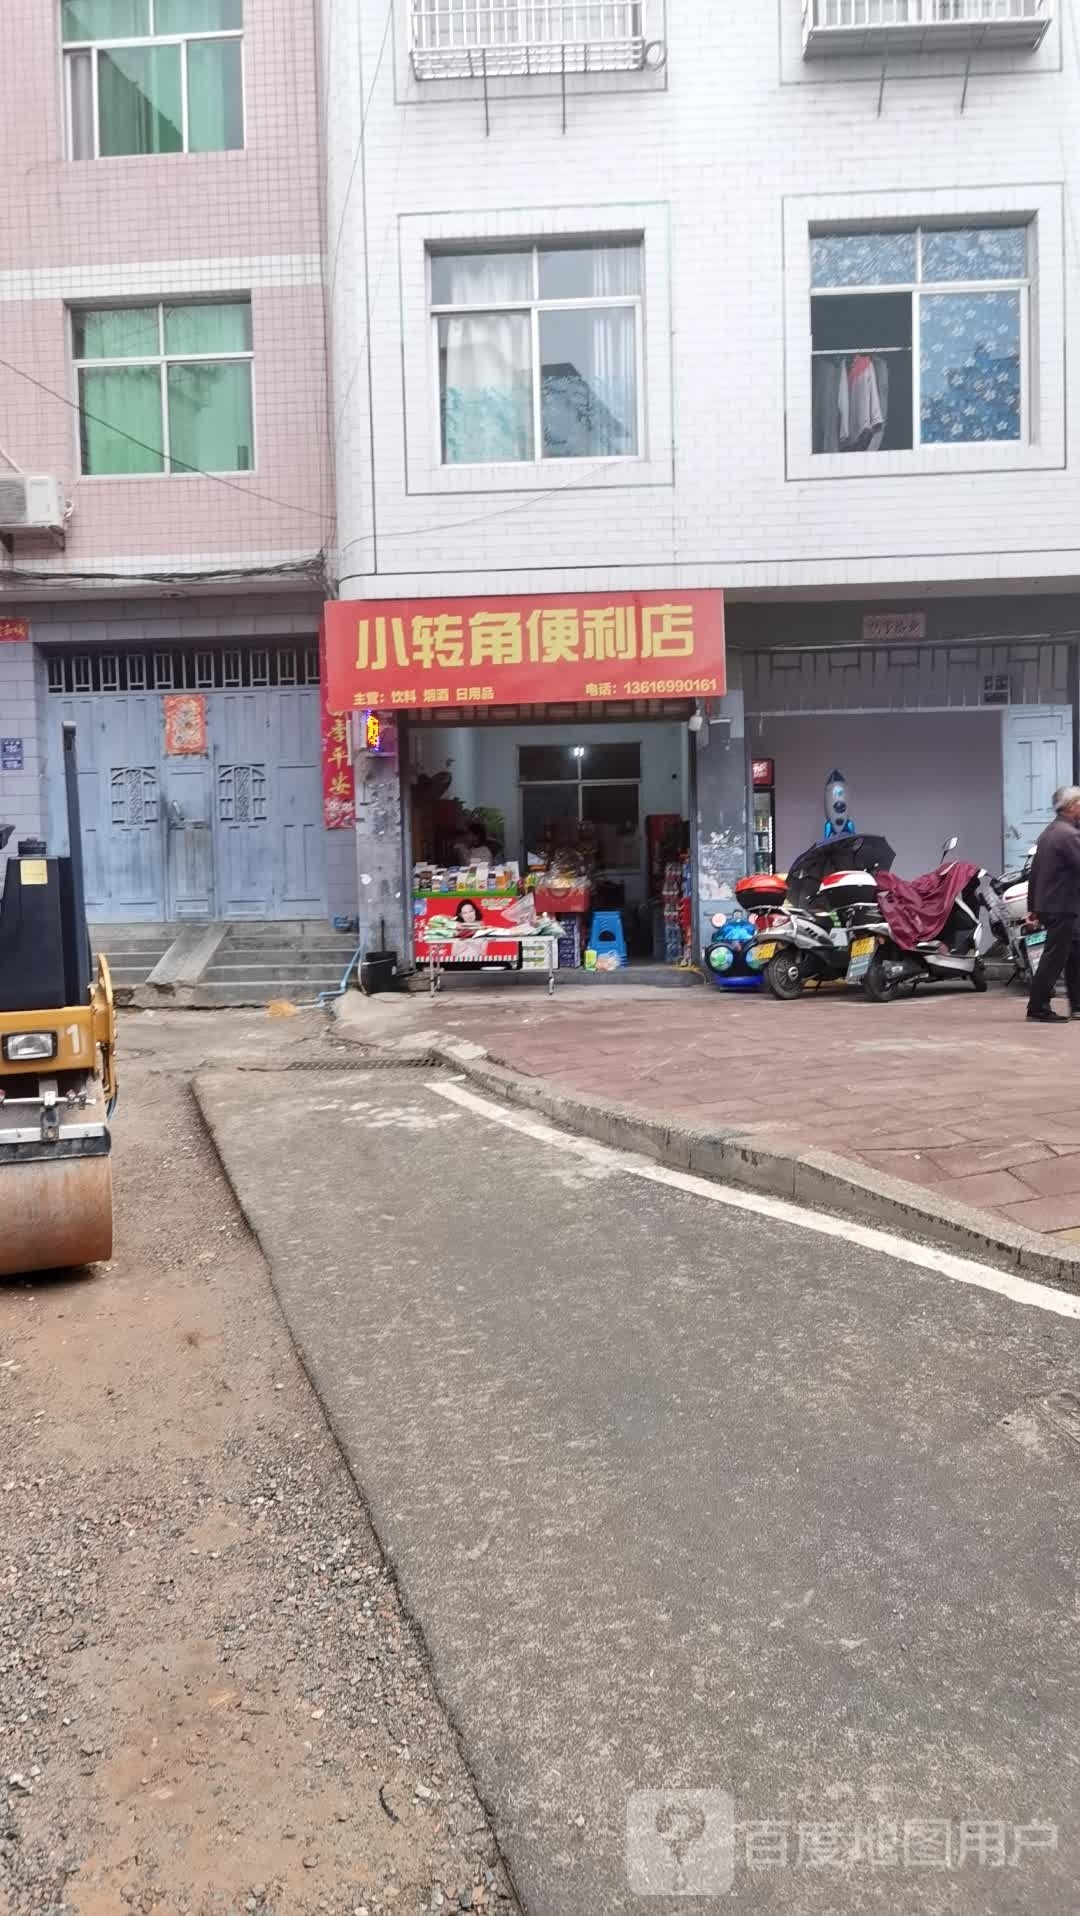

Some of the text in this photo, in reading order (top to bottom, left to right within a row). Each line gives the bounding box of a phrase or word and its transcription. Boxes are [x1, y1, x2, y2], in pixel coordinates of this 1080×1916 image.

[355, 604, 694, 670] 小转角便利店
[456, 686, 495, 701] 日用品
[66, 1024, 80, 1054] 1
